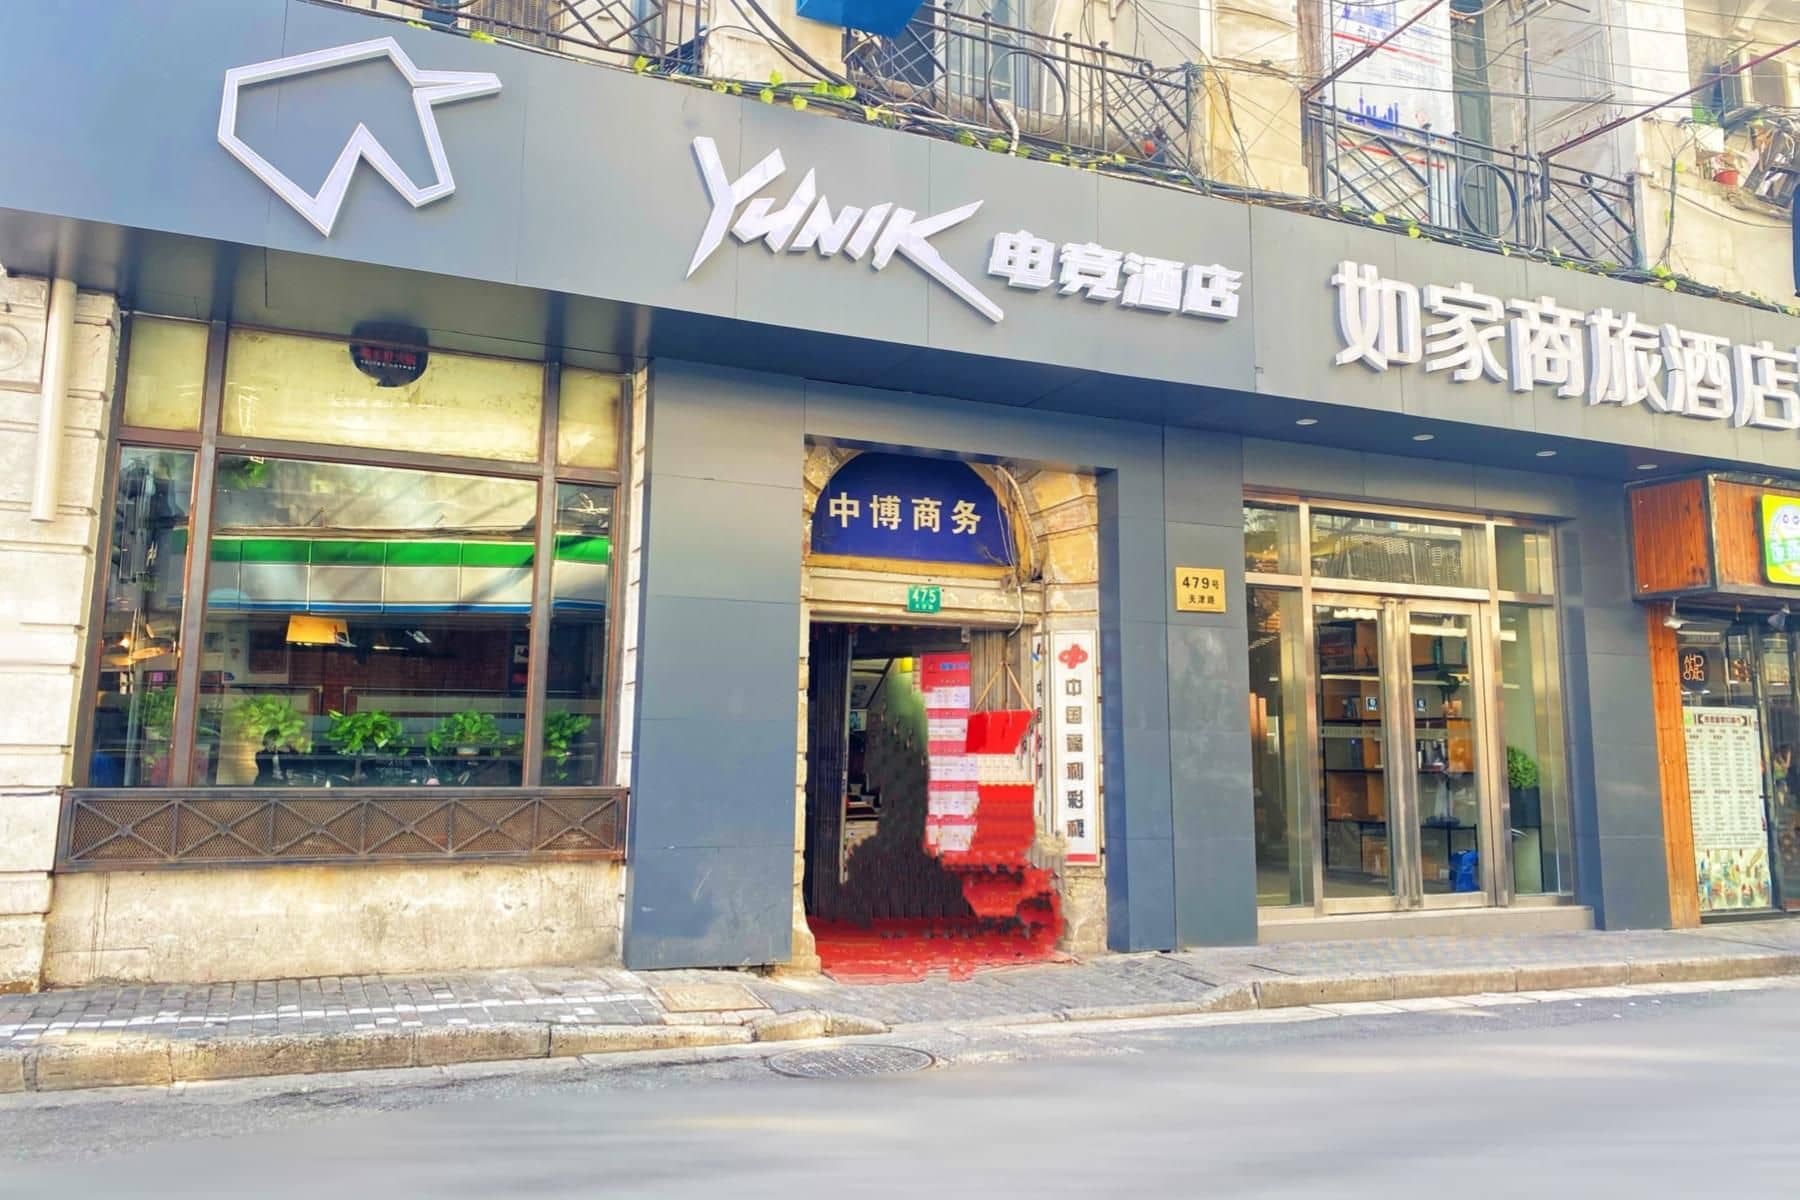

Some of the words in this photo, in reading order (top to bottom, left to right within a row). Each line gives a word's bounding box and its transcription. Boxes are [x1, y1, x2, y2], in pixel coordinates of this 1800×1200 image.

[988, 230, 1244, 319] 电竞酒店
[1331, 260, 1799, 430] 如家商旅酒店
[829, 492, 982, 535] 中博商务
[912, 589, 937, 603] 475
[1182, 576, 1220, 590] 479号
[1188, 594, 1215, 605] 天津路
